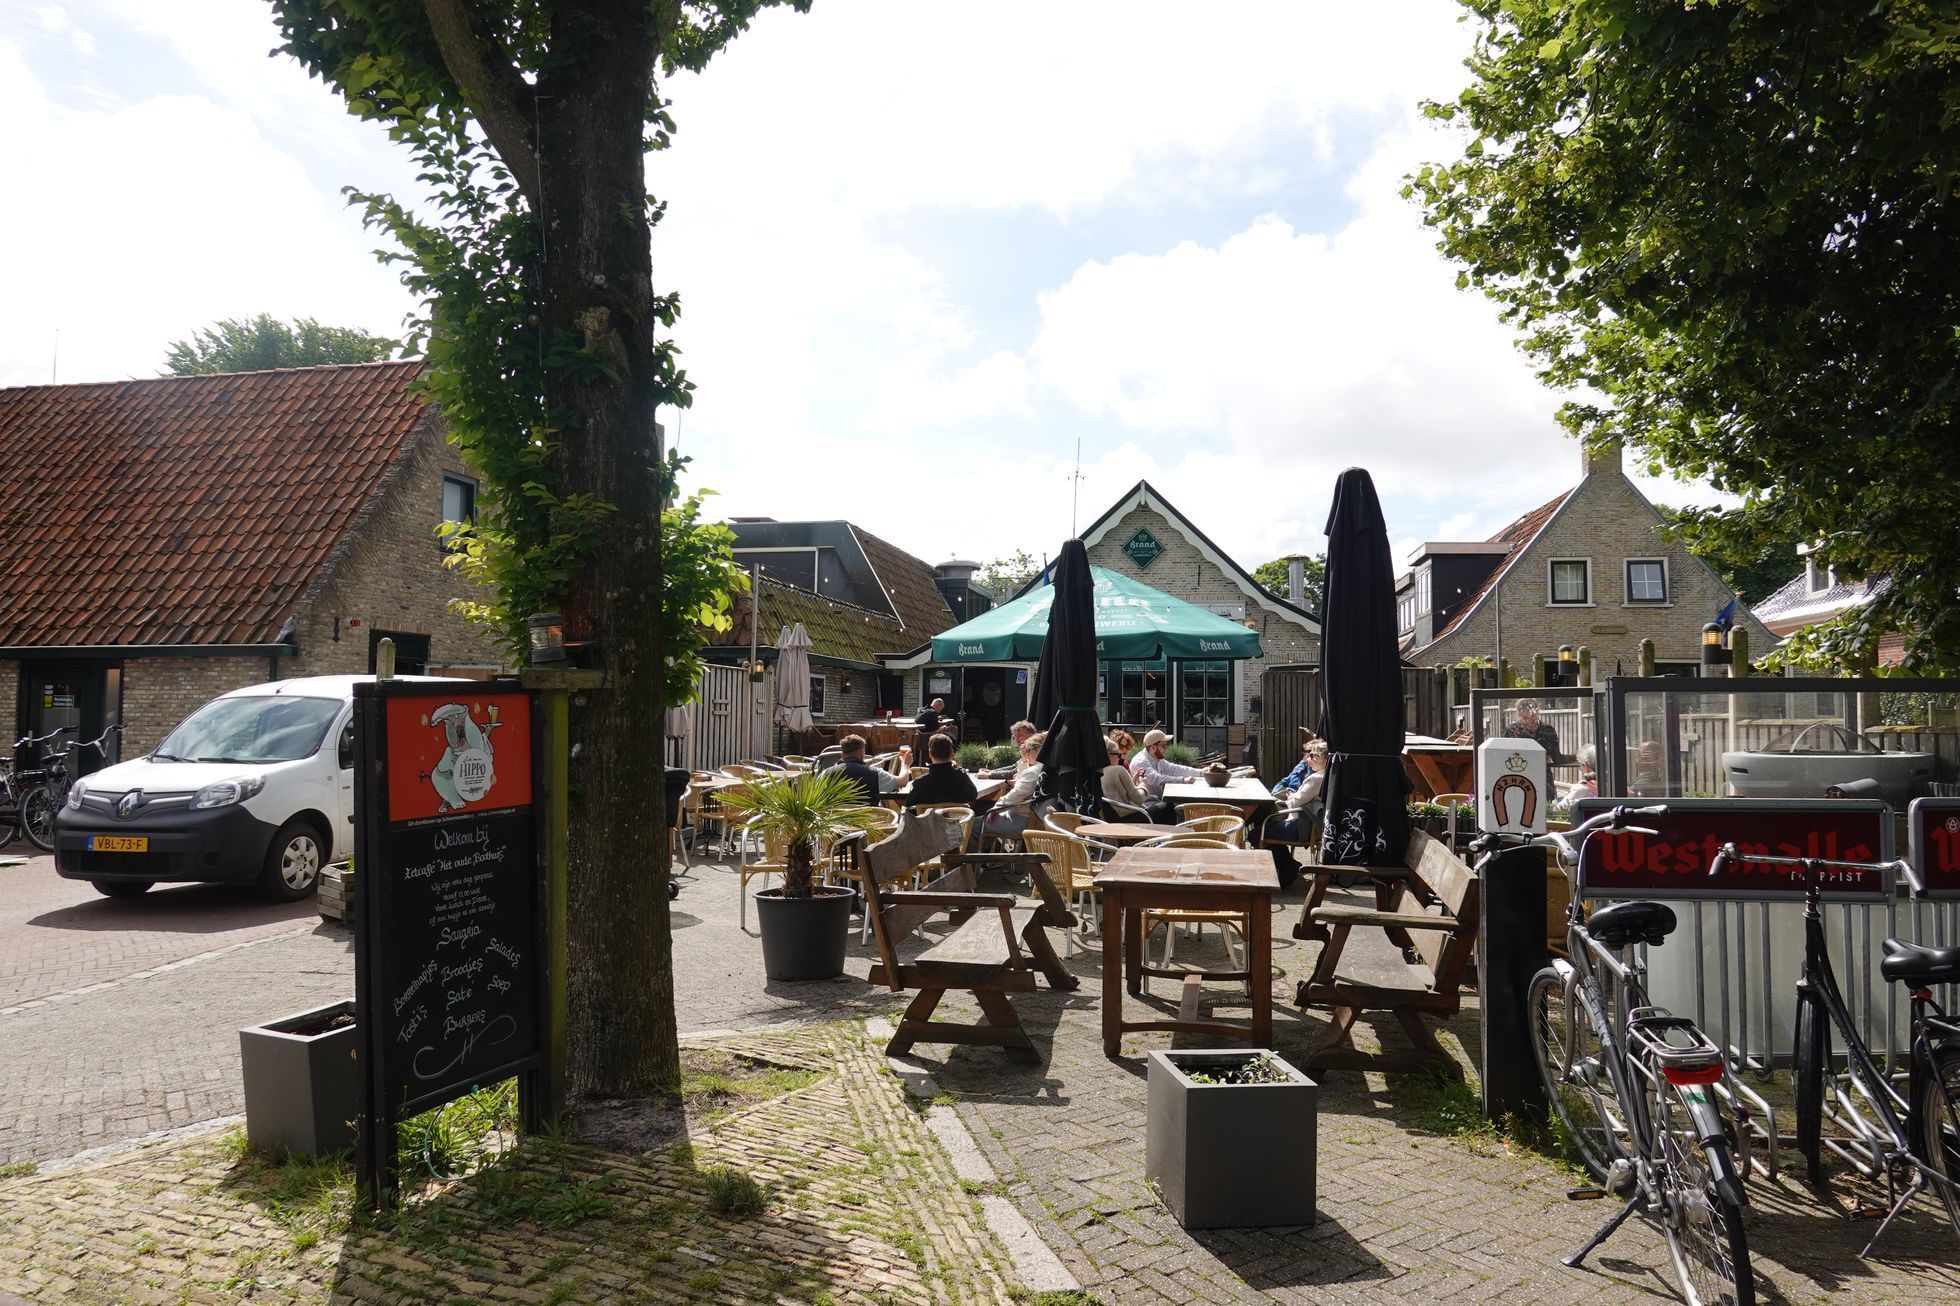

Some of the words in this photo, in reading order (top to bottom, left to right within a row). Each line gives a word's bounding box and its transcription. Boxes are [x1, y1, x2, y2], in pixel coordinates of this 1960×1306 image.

[1130, 540, 1156, 549] Brand
[958, 643, 984, 656] Brand
[1200, 638, 1231, 652] Brand
[459, 763, 486, 777] HIPPO
[98, 839, 143, 850] VBL-73-F
[434, 829, 475, 850] Welkom
[476, 824, 490, 851] bij
[454, 856, 472, 868] oude
[1595, 830, 1873, 874] Westmalle
[463, 876, 473, 887] dag
[485, 937, 520, 970] Salades
[441, 956, 483, 987] Broodjes
[394, 959, 438, 1016] Borrelhapjes
[446, 979, 475, 1011] Saté
[487, 975, 511, 995] Soep
[443, 1009, 486, 1039] Burgers
